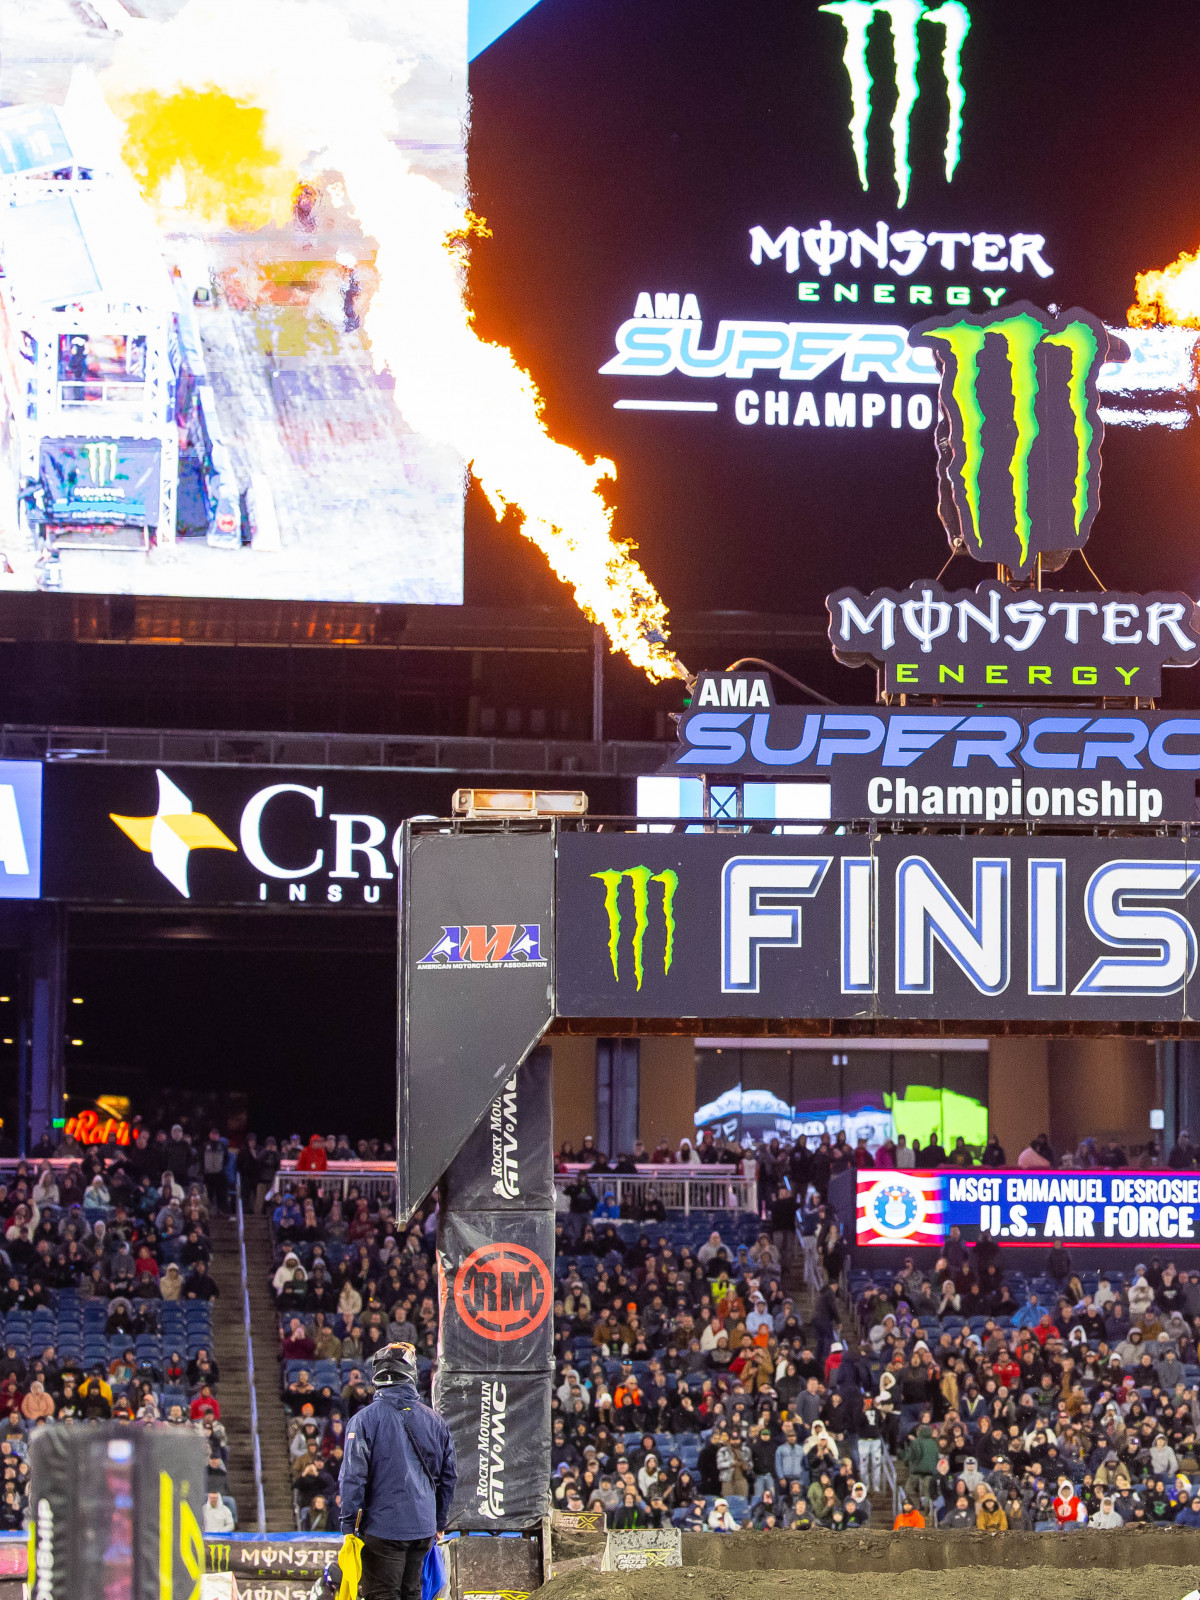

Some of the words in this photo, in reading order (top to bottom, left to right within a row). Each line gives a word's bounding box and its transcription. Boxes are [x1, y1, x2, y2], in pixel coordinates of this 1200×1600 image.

[748, 220, 1054, 277] MONSTER
[633, 291, 703, 320] AMA
[797, 281, 1008, 306] ENERGY
[735, 390, 943, 430] CHAMPIO
[838, 588, 1198, 652] MONSTER
[697, 678, 771, 708] AMA
[895, 662, 1141, 687] ENERGY
[866, 776, 1164, 823] Championship
[240, 783, 403, 879] CR
[415, 924, 549, 964] AMA
[491, 1096, 503, 1134] MOU
[490, 1136, 503, 1178] ROCKY
[949, 1177, 1002, 1203] MSGT
[1006, 1178, 1107, 1203] EMMANUEL
[979, 1205, 1036, 1237] U.S.
[1043, 1205, 1095, 1237] AIR
[1104, 1206, 1195, 1239] FORCE
[474, 1271, 533, 1312] RM
[477, 1380, 492, 1451] MOUNTAIN
[477, 1453, 489, 1498] ROCKY
[240, 1546, 341, 1568] MONSTE
